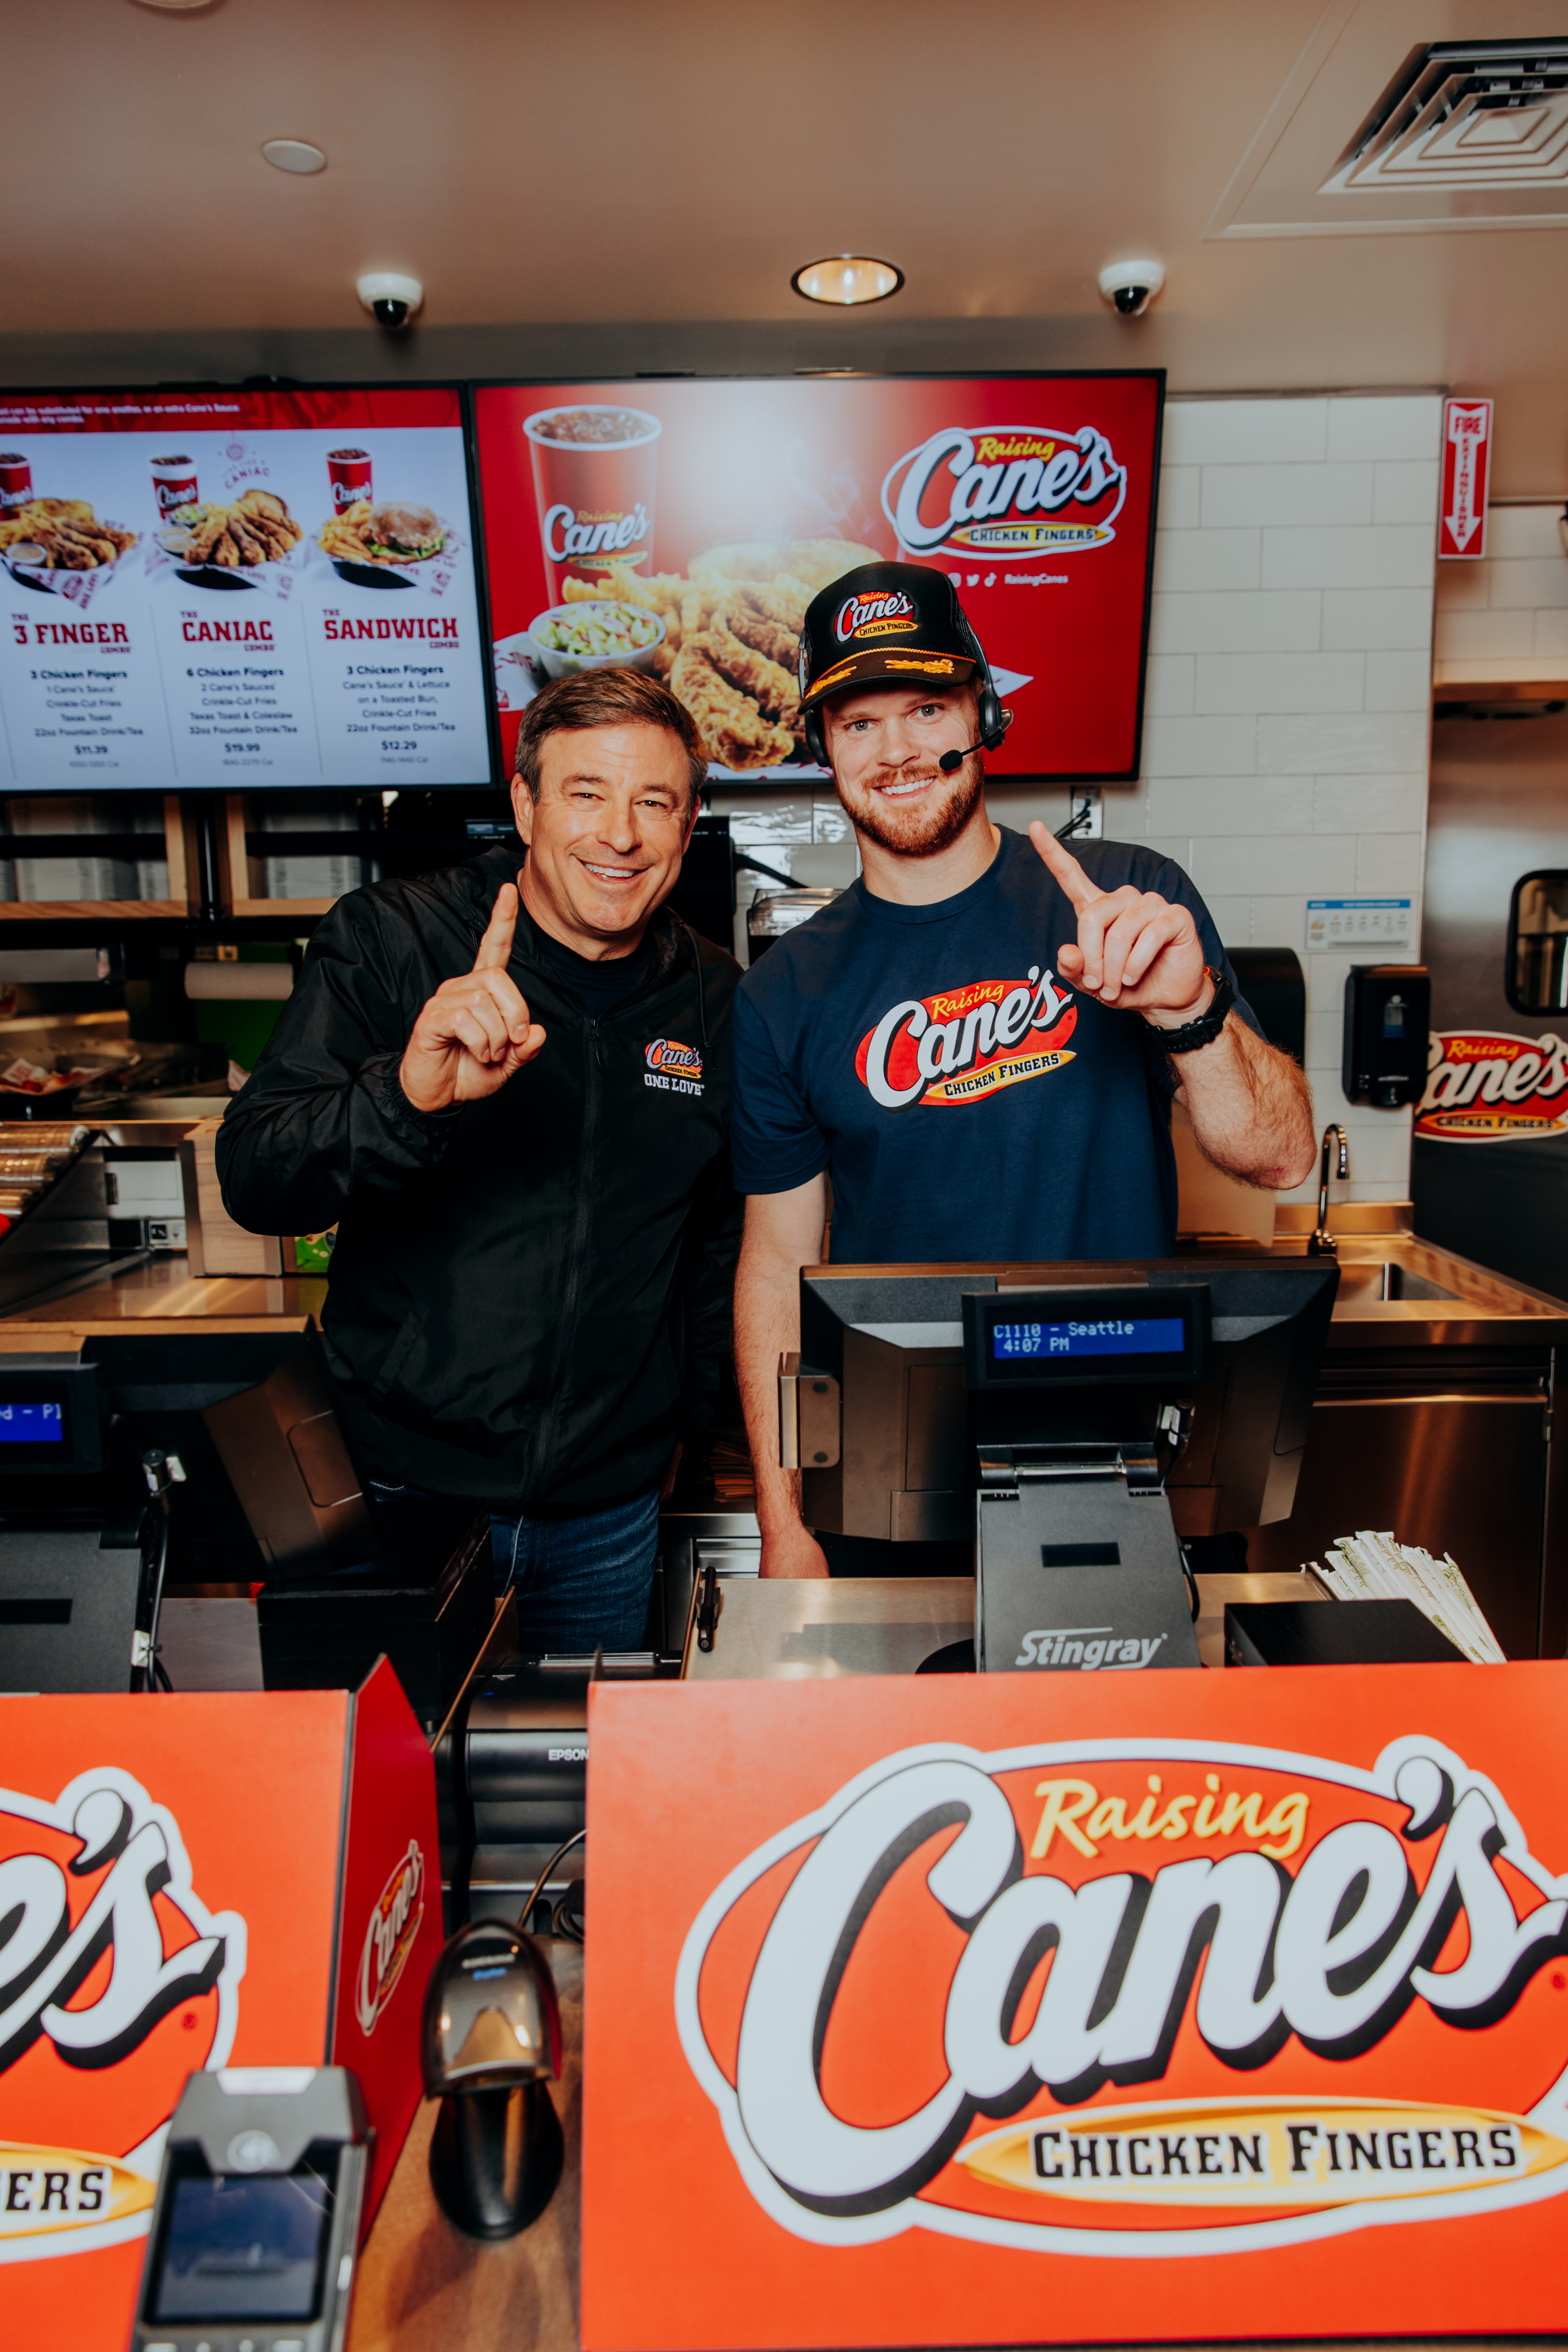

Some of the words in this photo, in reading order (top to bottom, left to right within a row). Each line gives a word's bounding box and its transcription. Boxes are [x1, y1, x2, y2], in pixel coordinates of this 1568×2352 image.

[1454, 416, 1482, 435] FIRE
[977, 436, 1056, 461] Raising
[896, 432, 1121, 548] Cane's
[1456, 438, 1470, 538] EXTINGUISHER
[543, 502, 650, 562] Cane's
[970, 528, 1029, 542] CHICKEN
[1035, 527, 1094, 541] FINGERS
[1004, 573, 1069, 587] RaisingCanes
[859, 592, 889, 604] Raising
[837, 591, 913, 642] Cane's
[14, 625, 27, 644] 3
[35, 623, 129, 643] FINGER
[183, 621, 273, 641] CANIAC
[324, 618, 458, 639] SANDWICH
[859, 624, 886, 637] CHICKEN
[887, 622, 914, 630] FINGERS
[31, 670, 37, 679] 3
[40, 668, 84, 678] Chicken
[87, 668, 128, 681] Fingers
[197, 667, 241, 677] Chicken
[244, 666, 284, 678] Fingers
[346, 665, 353, 675] 3
[357, 665, 400, 675] Chicken
[403, 664, 444, 676] Fingers
[343, 681, 373, 690] Cane's
[417, 680, 450, 689] Lettuce
[254, 696, 277, 705] Fries
[381, 695, 415, 704] Toasted
[362, 709, 412, 718] Crinkle-Cut
[415, 708, 437, 717] Fries
[213, 725, 253, 734] Fountain
[371, 723, 411, 732] Fountain
[413, 722, 456, 731] Drink/Tea
[381, 740, 417, 751] $12.29
[932, 985, 1004, 1020] Raising
[668, 1042, 688, 1053] Raising
[866, 965, 1074, 1112] Cane's
[647, 1039, 703, 1069] Cane's
[1448, 1039, 1519, 1061] Raising
[644, 1074, 670, 1089] ONE
[944, 1070, 996, 1096] CHICKEN
[999, 1052, 1060, 1079] FINGERS
[994, 1323, 1041, 1338] C1110
[1068, 1320, 1134, 1336] Seattle
[1003, 1338, 1041, 1353] 4:07
[1050, 1337, 1069, 1351] PM
[1015, 1627, 1162, 1670] Stingray
[548, 1748, 590, 1761] EPSON
[1029, 1774, 1310, 1862] Raising
[737, 1754, 1568, 2217] Cane's
[1031, 2125, 1263, 2181] CHICKEN
[1286, 2120, 1519, 2175] FINGERS
